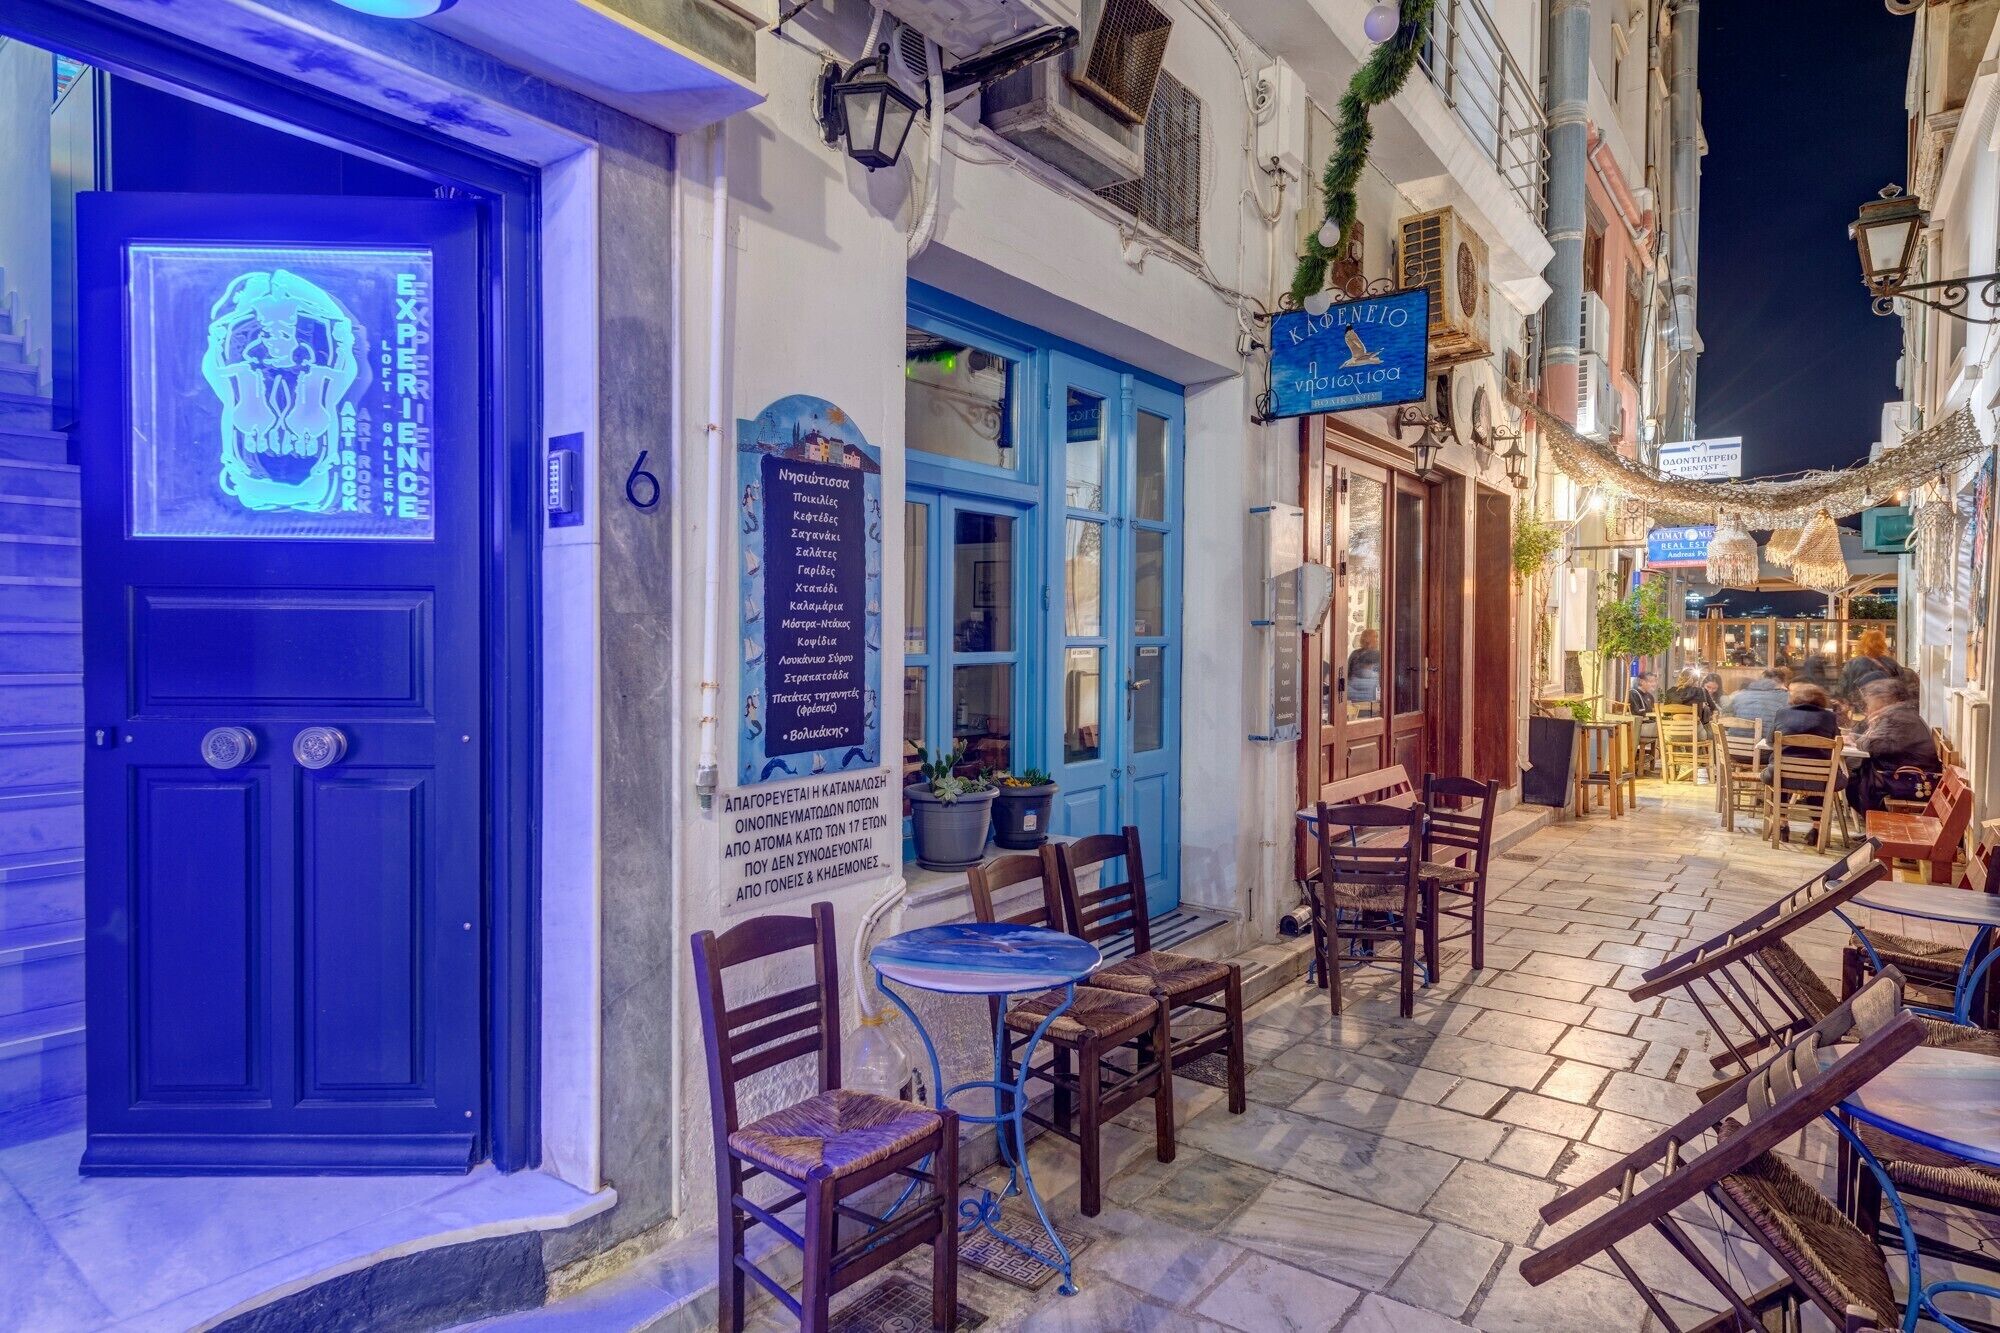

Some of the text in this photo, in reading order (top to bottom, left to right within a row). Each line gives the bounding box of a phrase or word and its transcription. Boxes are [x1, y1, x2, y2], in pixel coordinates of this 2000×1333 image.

[1288, 304, 1408, 345] ΚΑΦΕΝΕΙΟ
[381, 339, 393, 392] LOFT
[1309, 361, 1317, 380] η
[396, 273, 418, 518] EXPERIENCE
[340, 401, 357, 512] ART ROCK
[1662, 453, 1738, 466] ΟΔΟΝΤΙΑΤΡΕΙΟ
[382, 422, 394, 516] GALLERY
[1680, 463, 1719, 472] DENTIST
[626, 450, 660, 508] 6
[779, 468, 850, 489] Νησιώτισσα
[793, 492, 839, 508] Ποικιλίες
[793, 511, 839, 526] Κεφτέδες
[791, 528, 841, 542] Σαγανάκι
[795, 547, 838, 561] Σαλάτες
[798, 565, 836, 578] Γαρίδες
[795, 583, 838, 594] Χταπόδι
[790, 601, 843, 613] Καλαμάρια
[782, 618, 851, 631] Μόστρα-Ντάκος
[797, 636, 837, 649] Κοψίδια
[779, 653, 854, 665] Λουκάνικο Σύρου
[784, 671, 849, 684] Στραπατσάδα
[772, 687, 860, 704] Πατάτες τηγανητές
[796, 702, 837, 717] (φρέσκες)
[725, 775, 887, 813] ΑΠΑΓΟΡΕΥΕΤΑΙ Η ΚΑΤΑΝΑΛΩΣΗ
[735, 796, 879, 833] ΟΙΝΟΠΝΕΥΜΑΤΩΔΩΝ ΠΟΤΩΝ
[725, 813, 887, 859] ΑΠΟ ΑΤΟΜΑ ΚΑΤΩ ΤΩΝ 17 ΕΤΩΝ
[744, 837, 872, 877] ΠΟΥ ΔΕΝ ΣΥΝΟΔΕΥΟΝΤΑΙ
[736, 855, 879, 901] ΑΠΟ ΓΟΝΕΙΣ & ΚΗΔΕΜΟΝΕΣ
